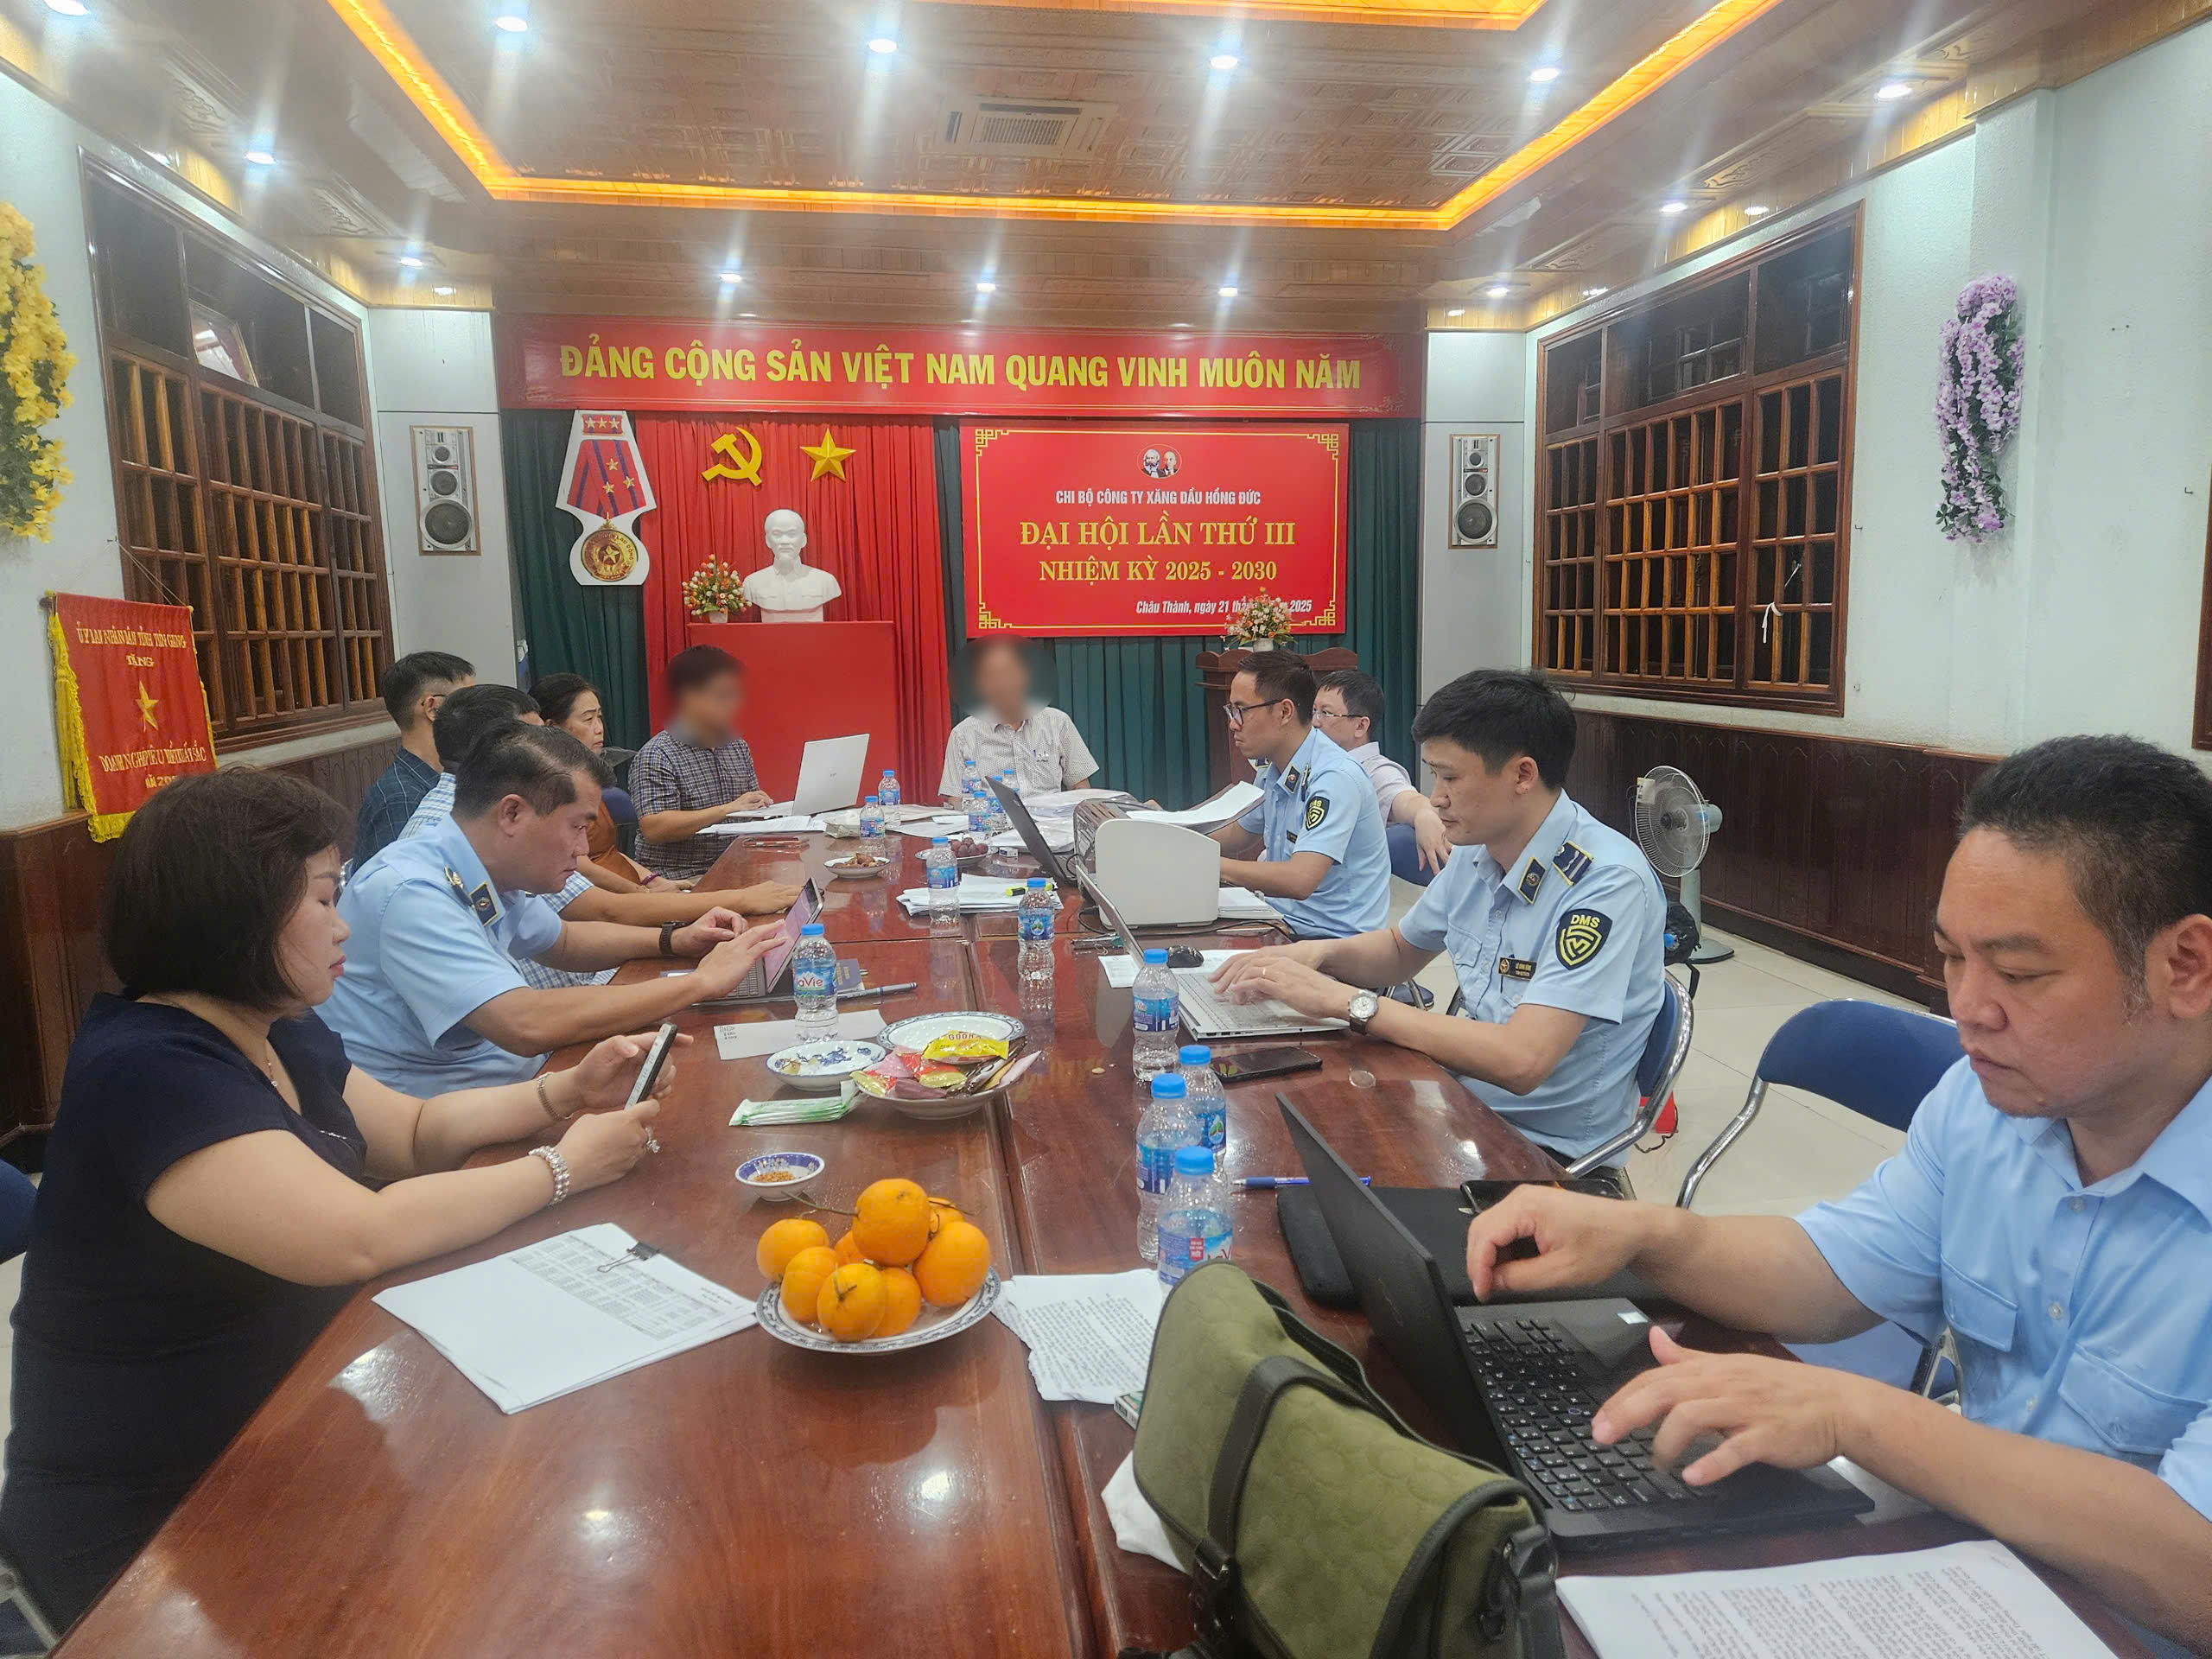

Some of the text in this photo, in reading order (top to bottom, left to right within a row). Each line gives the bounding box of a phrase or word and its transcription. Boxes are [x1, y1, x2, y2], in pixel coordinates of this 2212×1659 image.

[560, 333, 1361, 391] ĐẢNG CỘNG SẢN VIỆT NAM QUANG VINH MUÔN NĂM
[1055, 490, 1075, 504] CHI
[1077, 487, 1094, 506] BỘ
[1096, 487, 1128, 505] CÔNG
[1130, 490, 1144, 505] TY
[1147, 488, 1178, 505] XĂNG
[1180, 486, 1203, 505] DẦU
[1238, 488, 1262, 505] ĐỨC
[1020, 509, 1296, 551] ĐẠI HỘI LẦN THỨ III
[1039, 555, 1121, 586] NHIỆM
[1126, 554, 1159, 581] KỲ
[1165, 561, 1211, 581] 2025
[1231, 561, 1277, 581] 2030
[1135, 600, 1160, 614] Châu
[1162, 600, 1192, 615] Thành,
[1193, 600, 1217, 615] ngày
[1217, 600, 1230, 613] 21
[1289, 599, 1313, 613] 2025
[1570, 914, 1601, 929] DMS
